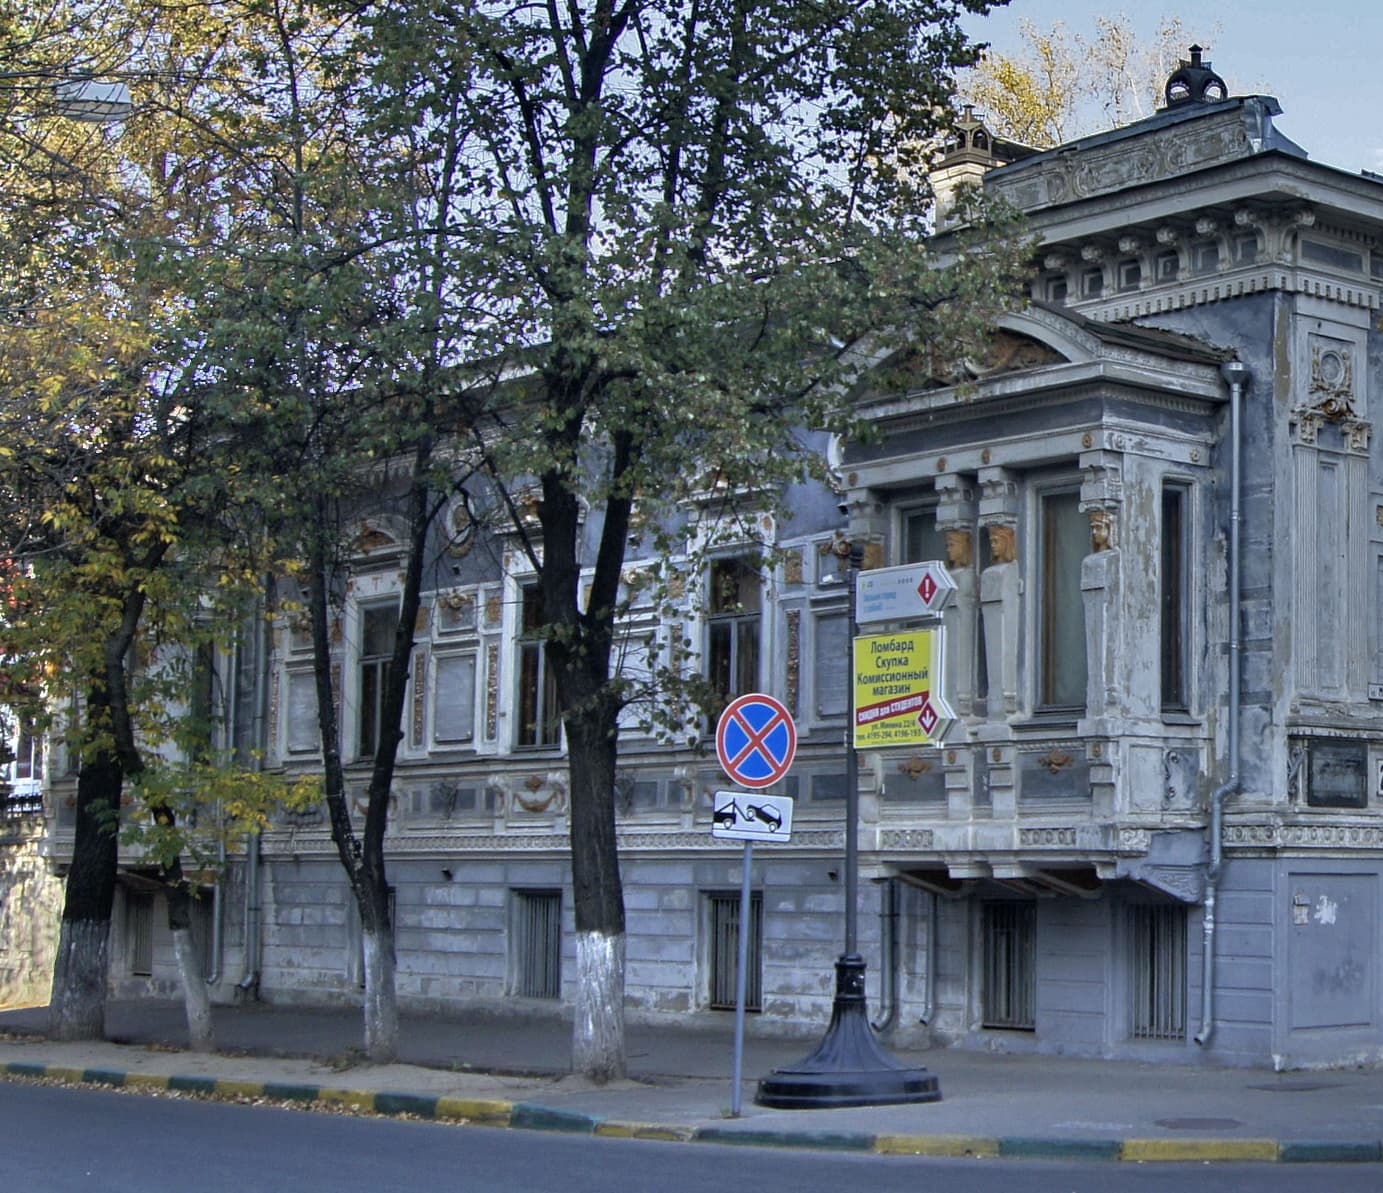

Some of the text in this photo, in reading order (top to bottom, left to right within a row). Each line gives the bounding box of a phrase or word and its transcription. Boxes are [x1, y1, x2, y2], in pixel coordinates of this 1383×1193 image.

[871, 639, 914, 654] Ломбард
[875, 656, 909, 671] Скупка
[857, 667, 928, 685] Комиссионный
[872, 685, 911, 696] магазин
